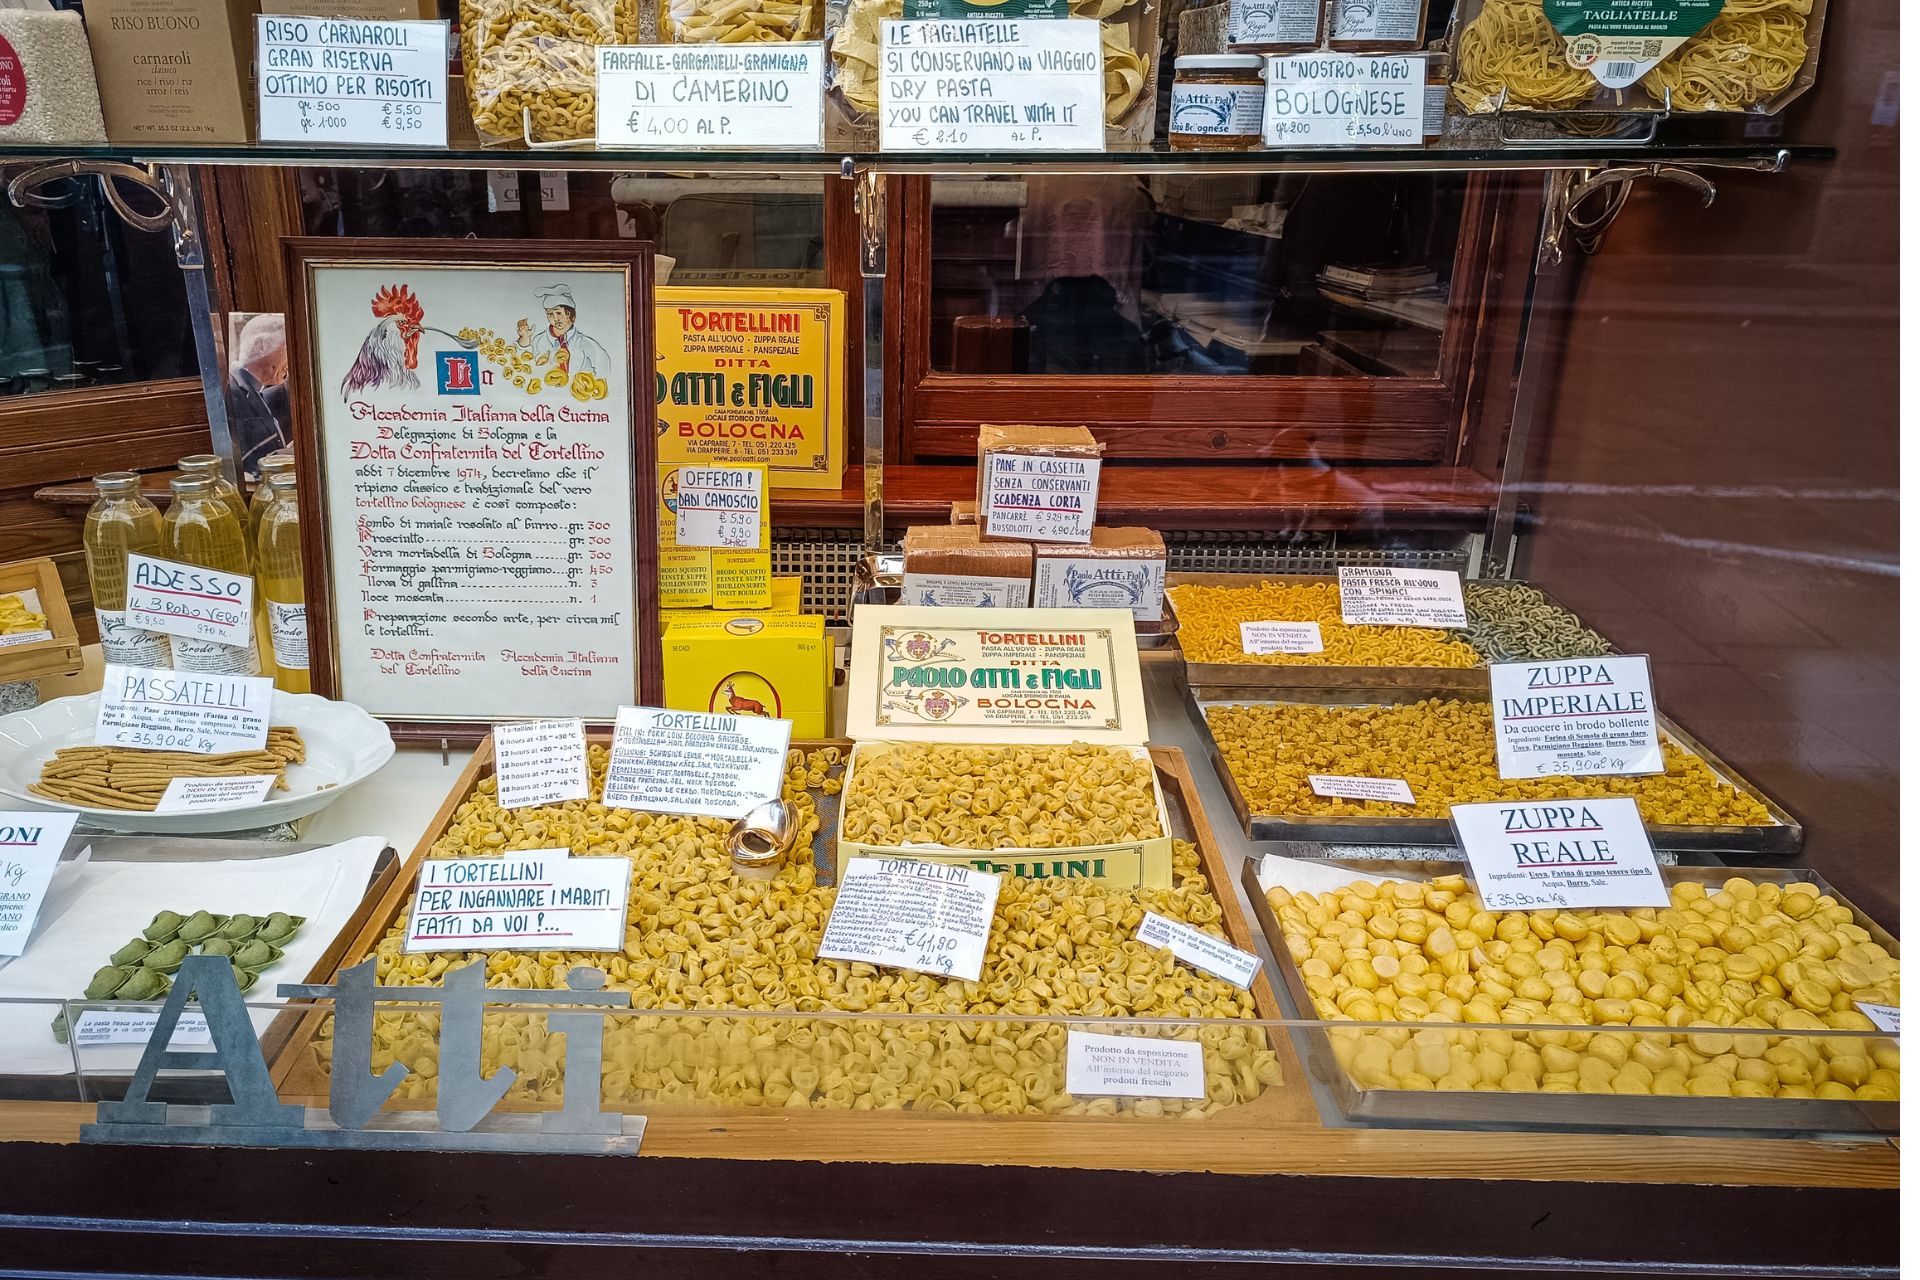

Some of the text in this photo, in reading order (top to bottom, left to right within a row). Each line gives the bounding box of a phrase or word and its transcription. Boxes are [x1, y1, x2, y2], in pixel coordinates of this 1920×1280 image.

[111, 16, 200, 30] RISO BUONO
[1583, 10, 1678, 21] TAGLIATELLE
[266, 21, 407, 46] RISO CARNAROLI
[891, 23, 1020, 45] LE TAGLIATELLE
[133, 51, 191, 65] carnaroli
[269, 49, 393, 71] GRAN RISERVA
[888, 52, 903, 72] SI
[911, 50, 1014, 72] CONSERVANO
[1038, 50, 1095, 70] VIAGGIO
[151, 66, 176, 74] classico
[1276, 62, 1286, 79] IL
[1370, 58, 1409, 79] RAGÙ
[266, 74, 432, 99] OTTIMO PER RISOTTI
[636, 75, 788, 102] DI CAMERINO
[890, 78, 992, 99] DRY PASTA
[1185, 93, 1210, 104] Atti
[1275, 88, 1404, 116] BOLOGNESE
[381, 103, 421, 115] € 5,50
[889, 103, 1077, 126] YOU CAN TRAVEL WITH IT
[381, 116, 421, 130] € 9,50
[627, 110, 731, 135] € 4,00 AL P.
[678, 309, 800, 333] TORTELLINI
[708, 335, 744, 343] ALL'UOVO
[715, 359, 770, 368] DITTA
[671, 372, 813, 408] ATTI FIGLI
[350, 402, 609, 423] Accademia Italiana della Cucina
[376, 427, 456, 444] Delegazione
[463, 427, 473, 439] di
[478, 427, 527, 443] Bologna
[547, 427, 557, 440] la
[678, 422, 804, 440] BOLOGNA
[350, 441, 604, 464] Dotta Confraternita del Tortellino
[996, 459, 1085, 474] PANE IN CASSETTA
[686, 470, 743, 487] OFFERTA
[994, 477, 1090, 491] SENZA CONSERVANTI
[355, 480, 591, 497] ripieno classico e tradizionale del vero
[679, 492, 758, 509] DADI CAMOSCIO
[993, 493, 1080, 508] SCADENZA CORTA
[992, 523, 1032, 533] BUSSOLOTTI
[137, 563, 241, 596] ADESSO
[1071, 569, 1122, 579] Paolo Atti
[1342, 568, 1392, 576] GRAMIGNA
[1342, 579, 1367, 587] PASTA
[361, 590, 444, 603] Noce moscata
[130, 597, 201, 617] IL BRODO
[977, 631, 1086, 645] TORTELLINI
[178, 642, 213, 653] Brodo
[893, 666, 1101, 689] PAOLO ATTI FIGLI
[1528, 664, 1613, 686] ZUPPA
[124, 676, 246, 707] PASSATELLI
[978, 699, 1096, 709] BOLOGNA
[1502, 691, 1646, 716] IMPERIALE
[163, 709, 199, 717] grattugiato
[652, 713, 736, 731] TORTELLINI
[1504, 718, 1649, 734] Da cuocere in brodo bollente
[131, 733, 176, 746] 35,90
[508, 795, 530, 803] month
[1500, 806, 1601, 830] ZUPPA
[1510, 840, 1615, 864] REALE
[431, 863, 543, 883] I TORTELLINI
[877, 860, 968, 882] TORTELLINI
[1489, 872, 1527, 880] Ingredienti:
[420, 888, 609, 911] PER INGANNARE I MARITI
[417, 915, 527, 935] FATTI DA VOI
[936, 954, 953, 975] Kg
[97, 956, 631, 1133] Atti
[1085, 1045, 1122, 1054] Prodotto
[1137, 1050, 1188, 1058] esposizione
[1086, 1065, 1135, 1074] All'interno
[1133, 1058, 1181, 1067] VENDITA
[1104, 1077, 1171, 1086] prodotti freschi
